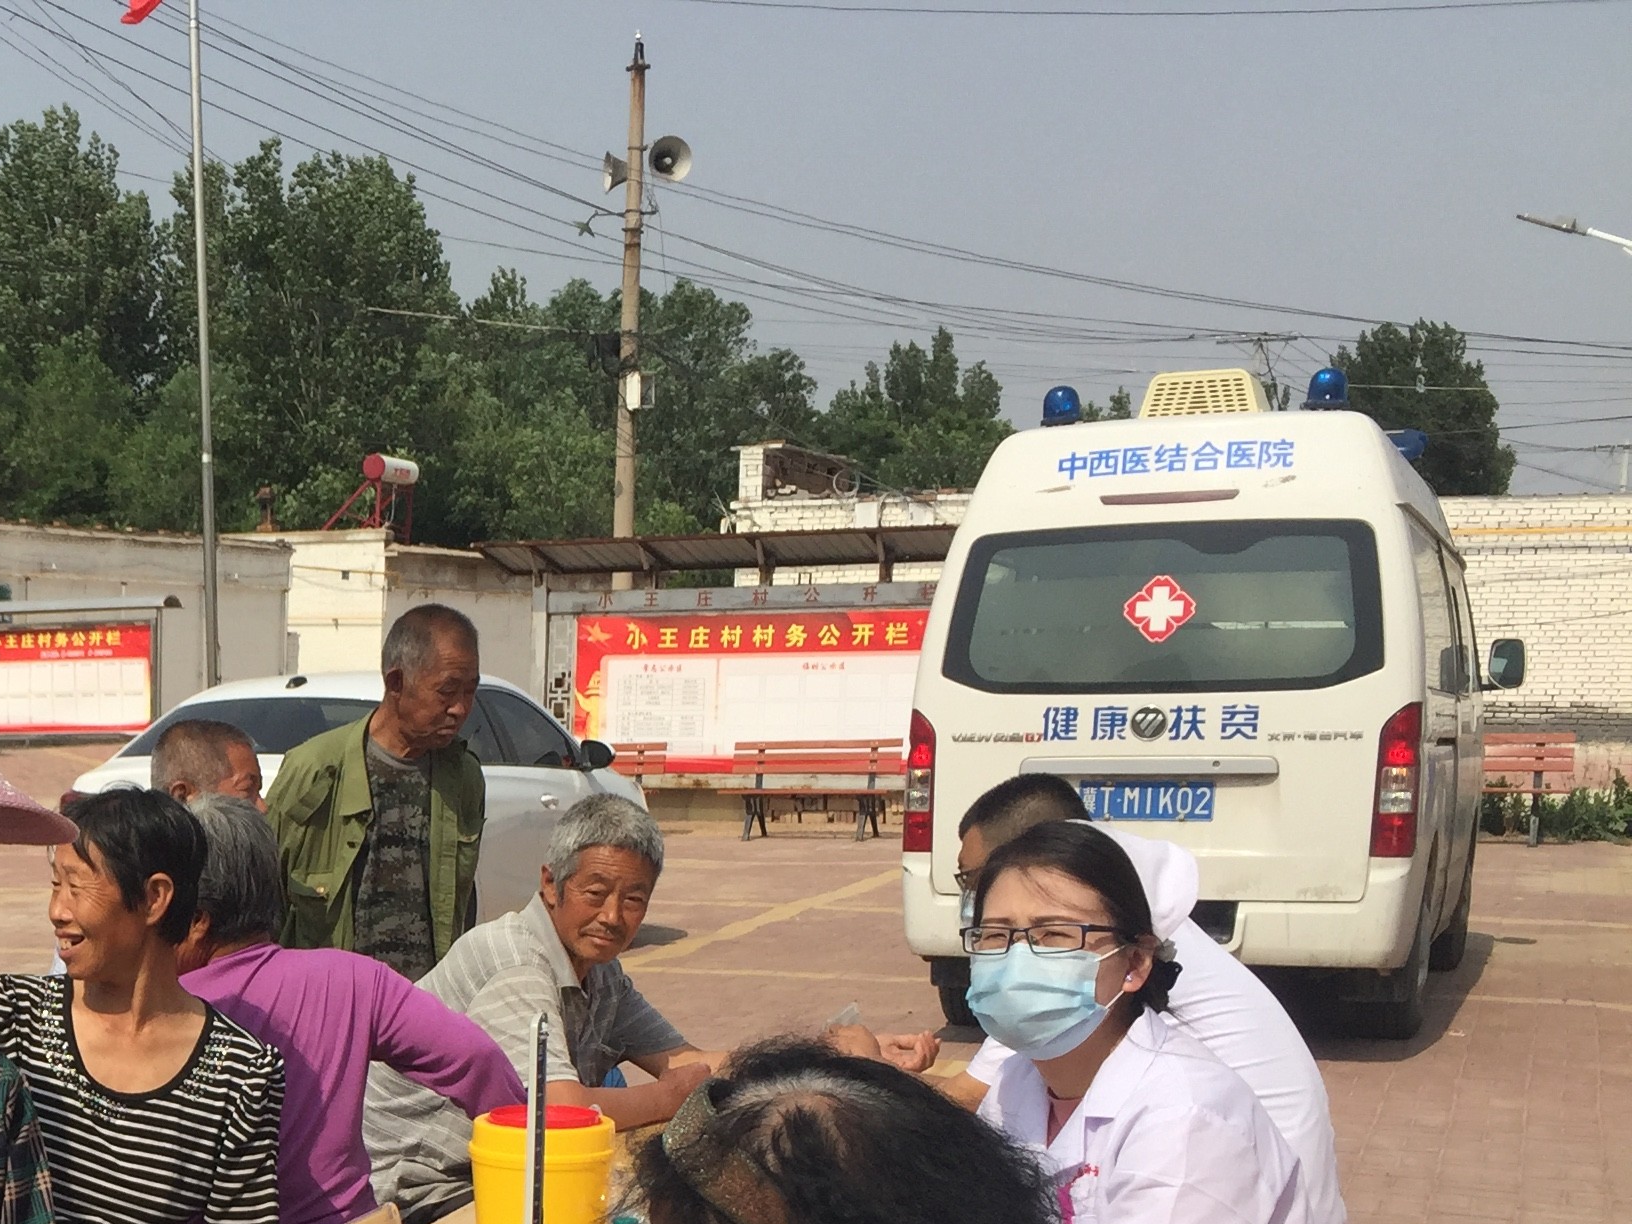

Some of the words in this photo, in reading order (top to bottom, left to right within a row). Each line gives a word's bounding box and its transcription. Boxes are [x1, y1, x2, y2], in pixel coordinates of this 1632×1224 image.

[1057, 438, 1295, 481] 中西医结合医院
[625, 621, 909, 650] 小王庄村村务公开栏
